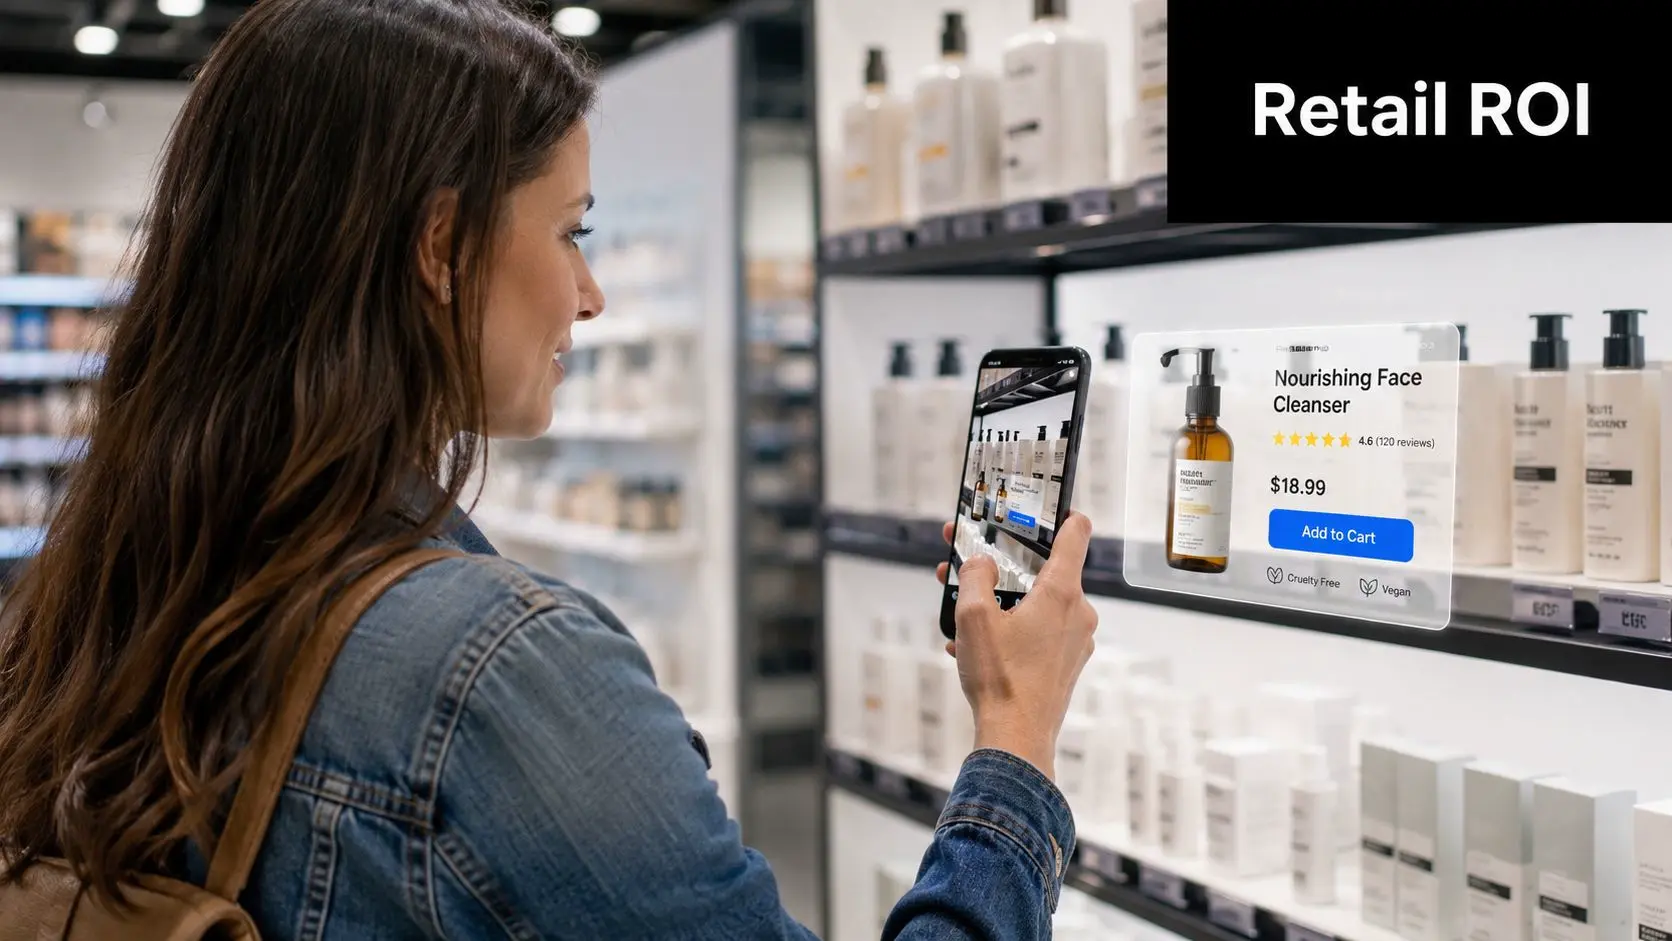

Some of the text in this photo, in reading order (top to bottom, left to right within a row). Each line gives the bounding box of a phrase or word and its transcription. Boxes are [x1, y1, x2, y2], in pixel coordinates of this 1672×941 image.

[1275, 368, 1423, 391] Nourishing Face
[1273, 394, 1351, 414] Cleanser
[1358, 436, 1435, 449] 4.6 (120 reviews)
[1270, 475, 1327, 497] $18.99
[1301, 525, 1376, 545] Add to Cart
[1287, 573, 1341, 589] Cruelty Free
[1382, 584, 1411, 598] Vegan
